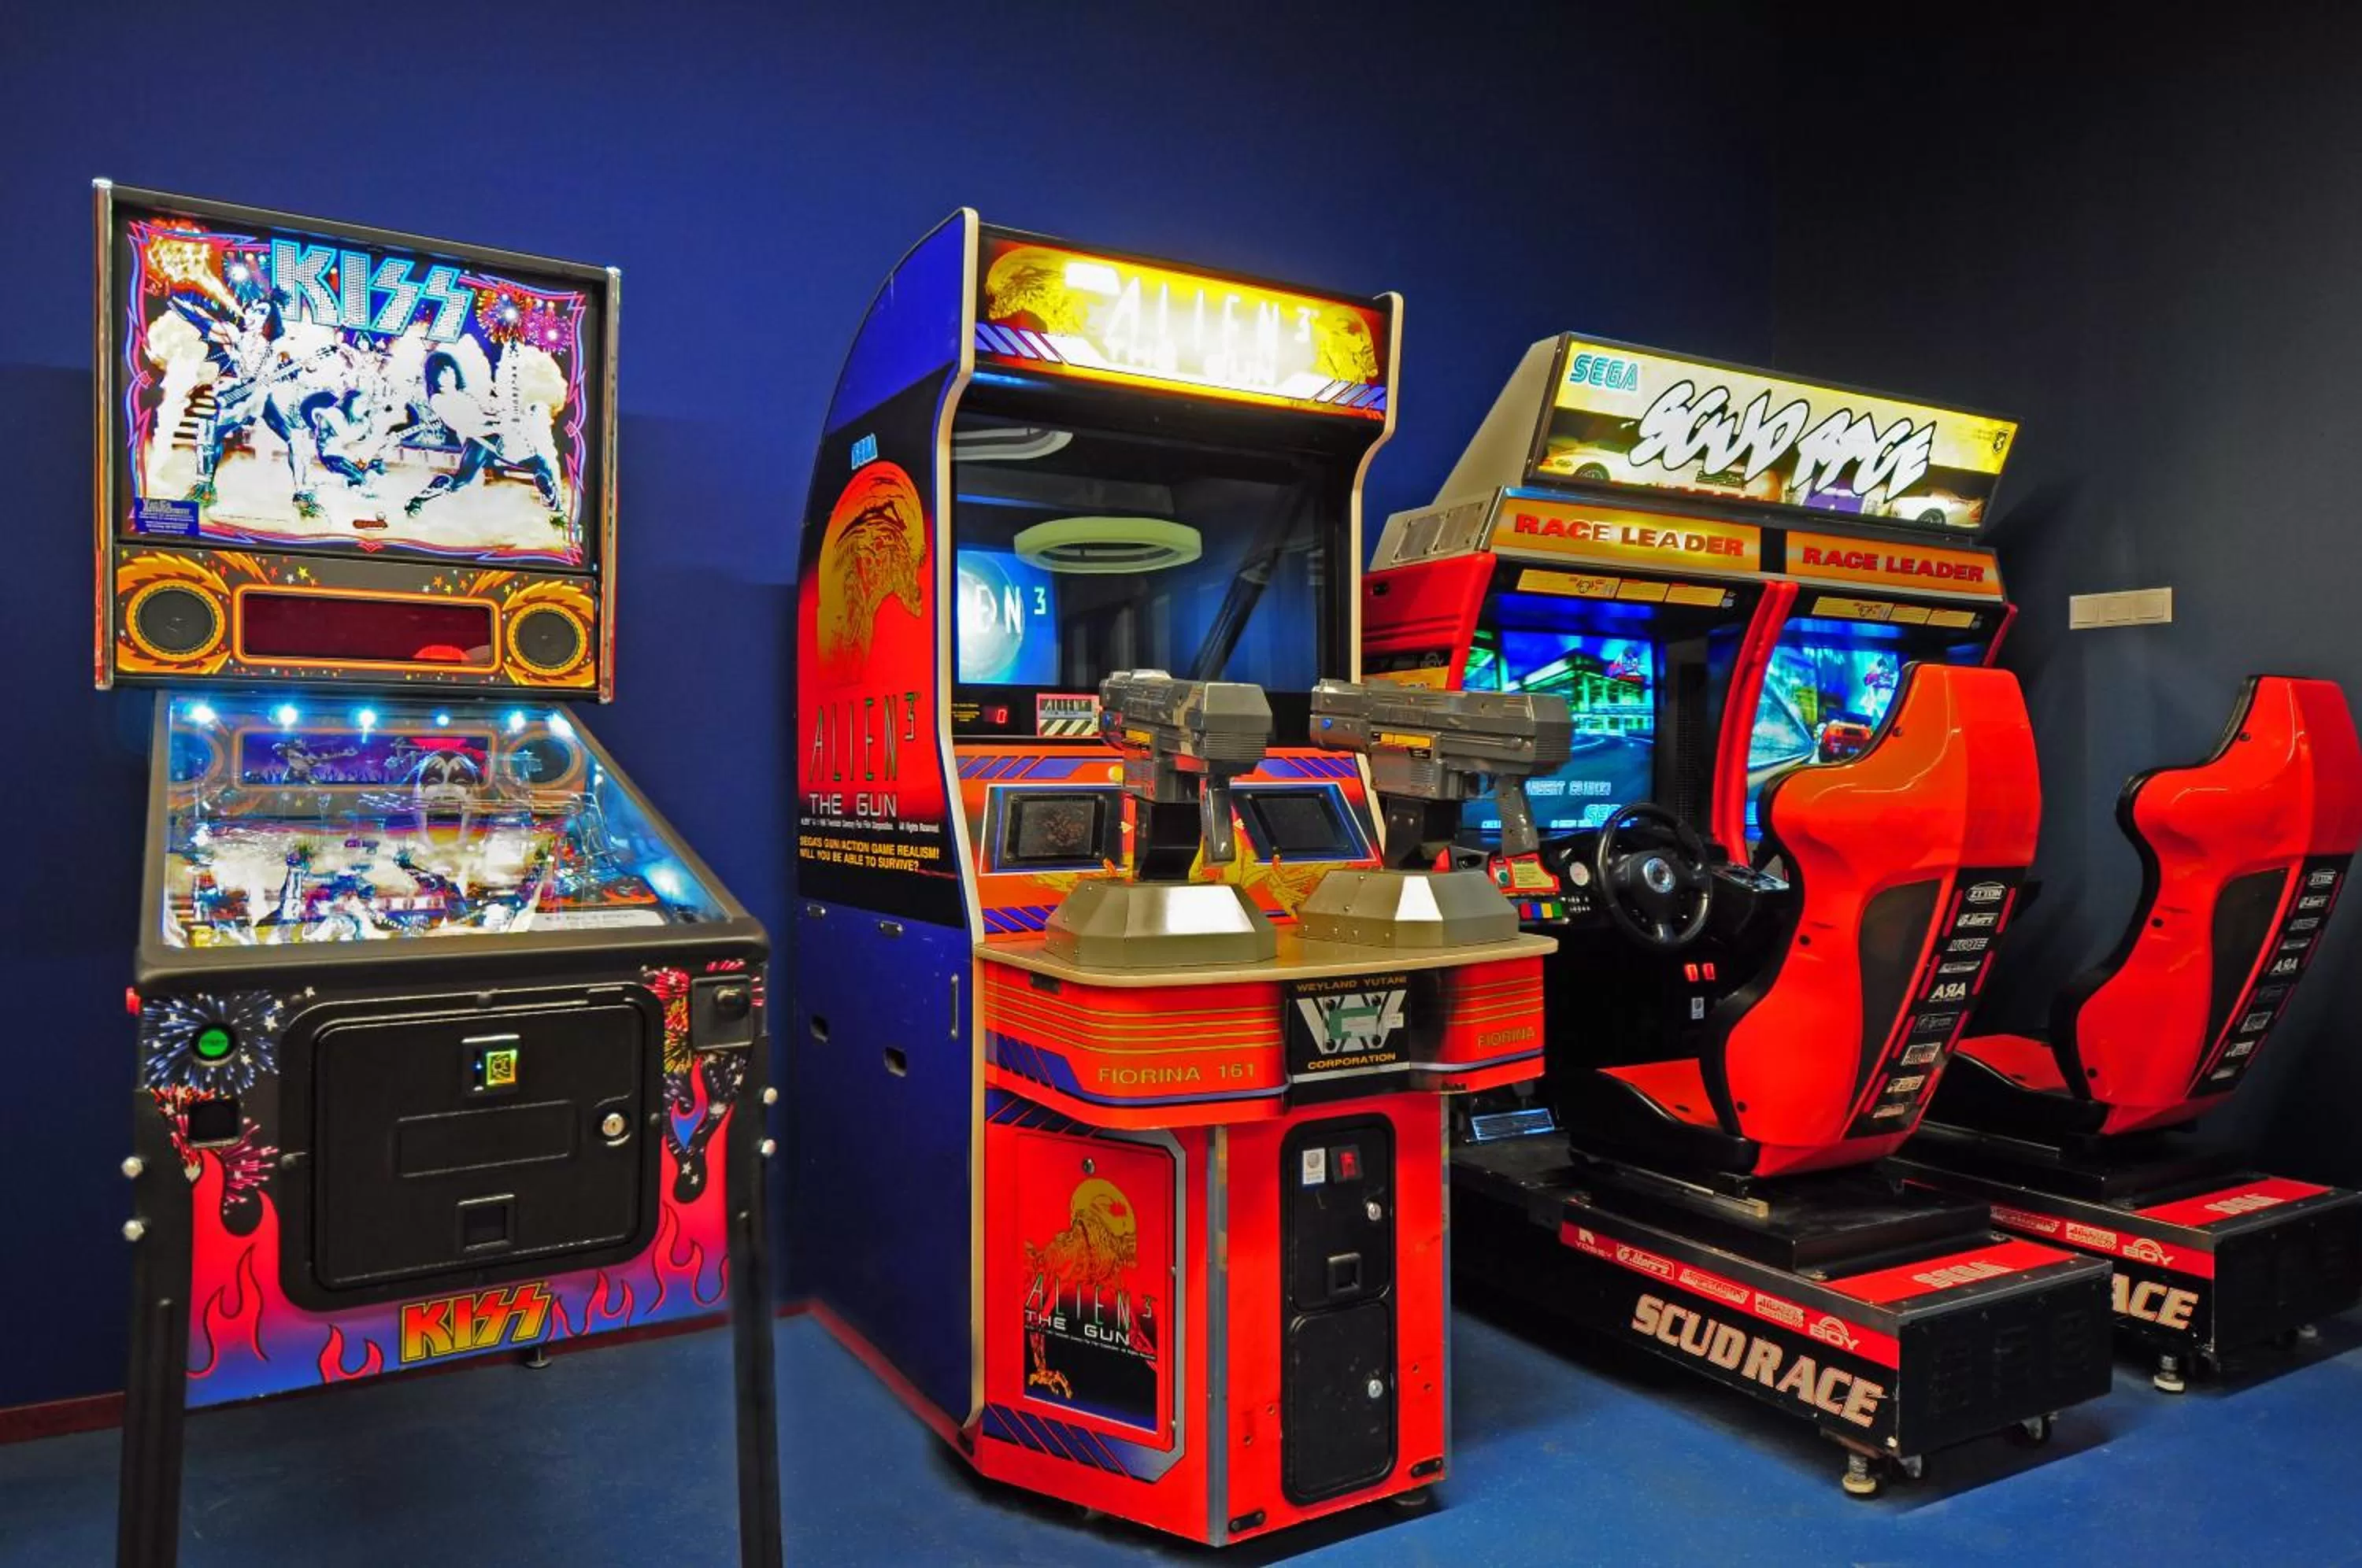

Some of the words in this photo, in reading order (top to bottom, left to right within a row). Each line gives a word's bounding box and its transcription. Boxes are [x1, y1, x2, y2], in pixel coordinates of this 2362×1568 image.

[271, 239, 474, 343] KISS
[1569, 353, 1640, 392] SEGA
[1628, 379, 1811, 484] SCUD
[1515, 513, 1611, 542] RACE
[1621, 527, 1745, 557] LEADER
[1802, 547, 1878, 571] RACE
[1886, 557, 1985, 582] LEADER
[809, 694, 898, 782] ALIEN
[809, 793, 843, 815] THE
[856, 793, 898, 818] GUN
[799, 848, 815, 859] WILL
[817, 850, 830, 862] YOU
[832, 852, 842, 863] BE
[843, 854, 864, 865] ABLE
[865, 856, 876, 867] TO
[878, 858, 920, 872] SURVIVE?
[842, 839, 869, 852] ACTION
[872, 842, 895, 856] GAME
[897, 845, 939, 860] REALISM!
[1298, 980, 1357, 993] WEYLAND
[1363, 975, 1407, 987] YUTANI
[1478, 1026, 1535, 1049] FIORINA
[1098, 1067, 1201, 1084] FIORINA
[1218, 1063, 1255, 1079] 161
[1308, 1052, 1396, 1070] CORPORATION
[1025, 1273, 1131, 1332] ALIEN
[402, 1282, 552, 1363] KISS
[1024, 1309, 1067, 1331] THE
[1083, 1324, 1131, 1346] GUN
[1809, 1322, 1860, 1351] BOY
